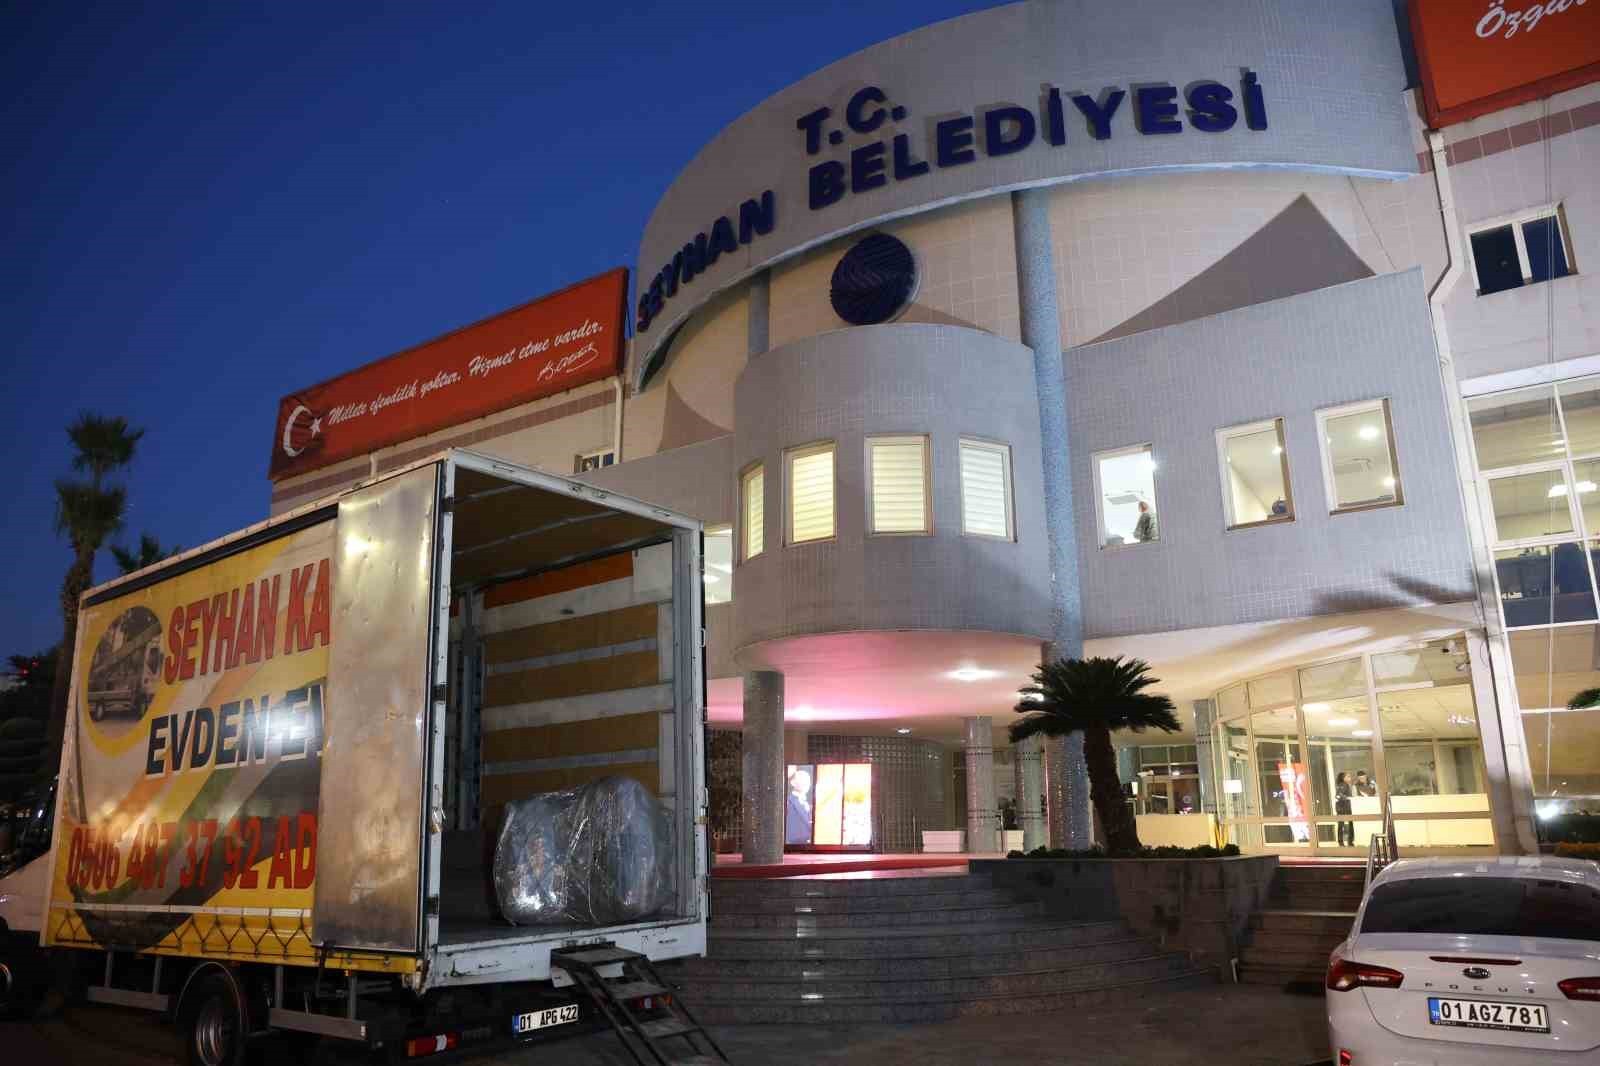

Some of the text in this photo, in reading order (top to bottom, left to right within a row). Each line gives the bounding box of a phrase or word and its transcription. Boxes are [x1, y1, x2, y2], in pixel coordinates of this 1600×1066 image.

[797, 86, 907, 155] T.C.
[637, 70, 1268, 333] SEYHAN BELEDİYESİ
[468, 347, 516, 378] Hizmet
[518, 338, 551, 360] etme
[164, 574, 281, 685] SEYHAN
[145, 694, 271, 775] EVDEN
[127, 820, 177, 889] 487
[179, 818, 219, 890] 37
[223, 815, 262, 890] 92
[520, 1015, 532, 1030] 01
[540, 1010, 558, 1026] APG
[560, 1006, 577, 1022] 422
[1441, 1002, 1462, 1020] 01
[1468, 1004, 1503, 1023] AGZ
[1505, 1006, 1543, 1026] 781
